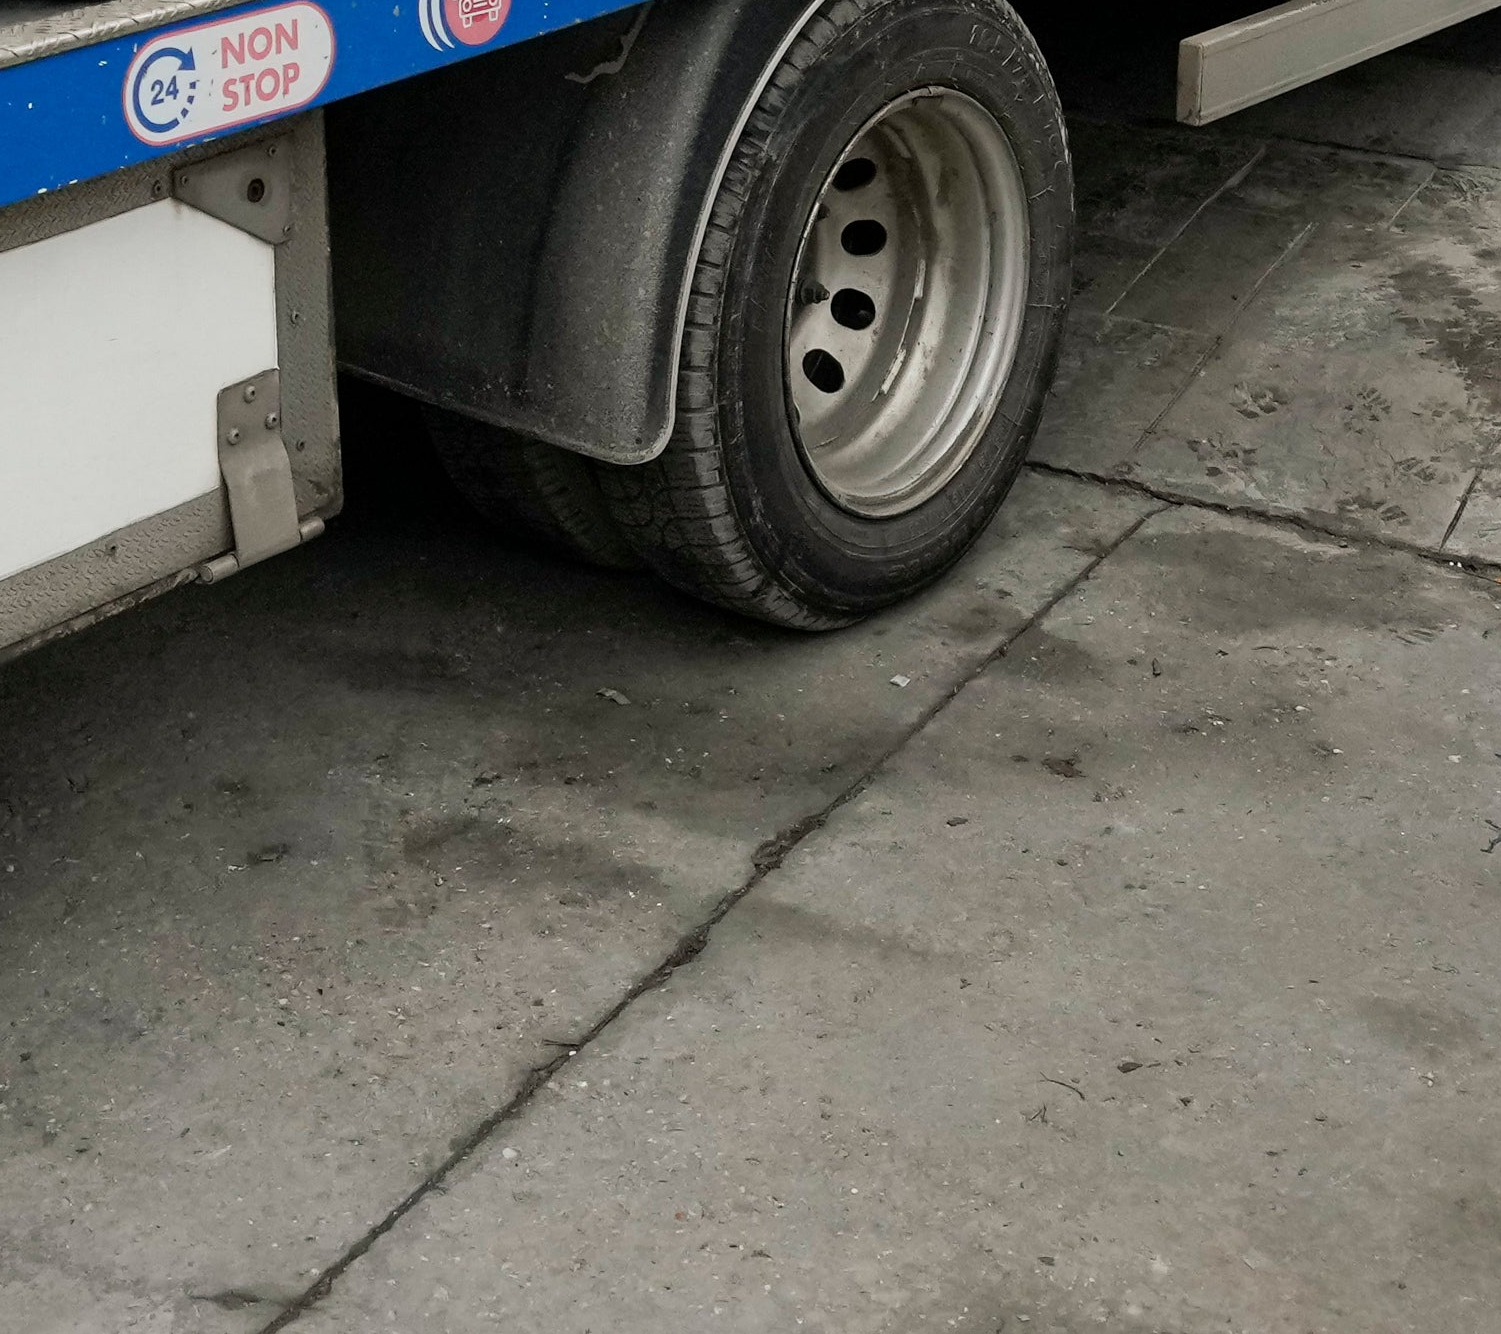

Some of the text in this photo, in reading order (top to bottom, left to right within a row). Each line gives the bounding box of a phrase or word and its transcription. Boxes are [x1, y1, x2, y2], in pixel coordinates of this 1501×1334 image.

[220, 18, 299, 70] NON
[149, 75, 180, 107] 24
[221, 62, 300, 113] STOP
